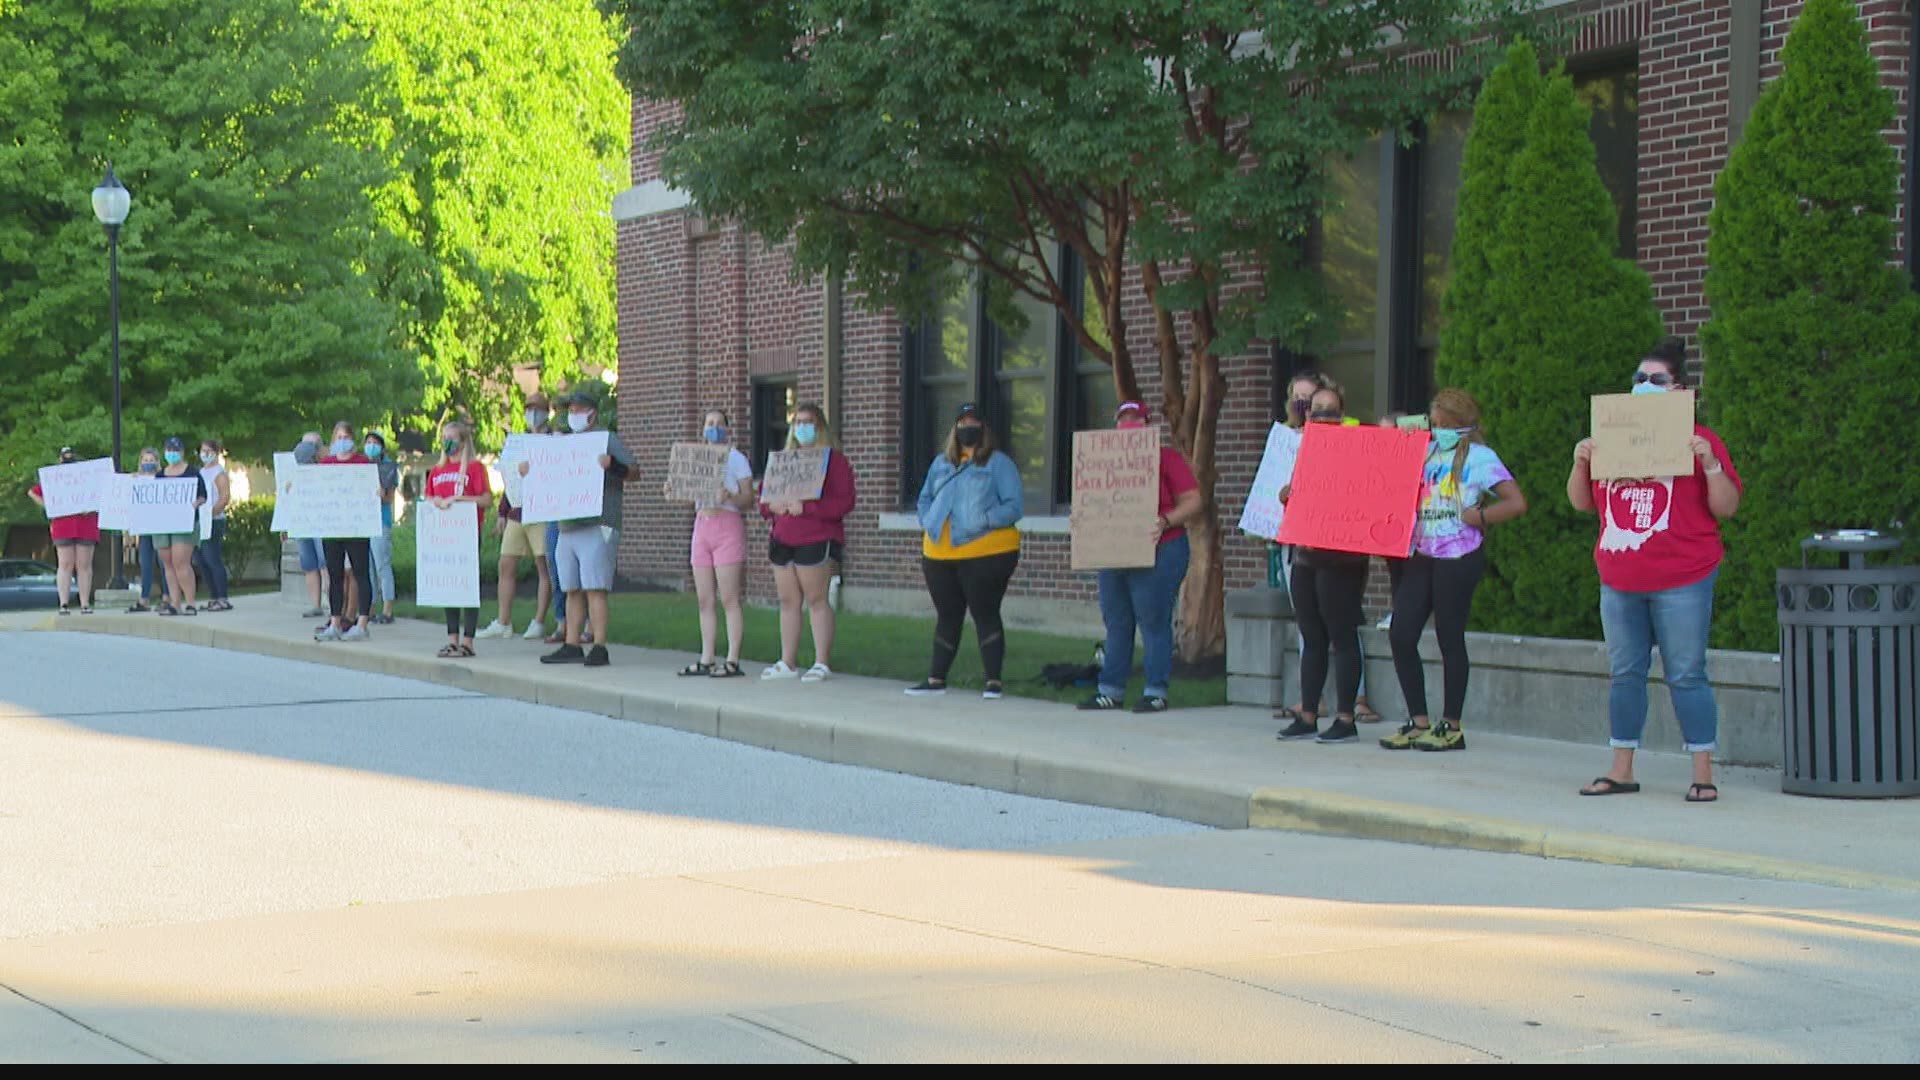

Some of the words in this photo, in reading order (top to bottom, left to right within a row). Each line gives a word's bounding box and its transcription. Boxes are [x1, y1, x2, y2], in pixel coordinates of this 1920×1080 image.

[1090, 430, 1156, 450] THOUGHT
[1075, 467, 1102, 490] DATA
[131, 482, 197, 505] NEGLIGENT
[1620, 487, 1655, 502] #RED
[1629, 501, 1654, 515] FOR
[1635, 515, 1652, 528] ED
